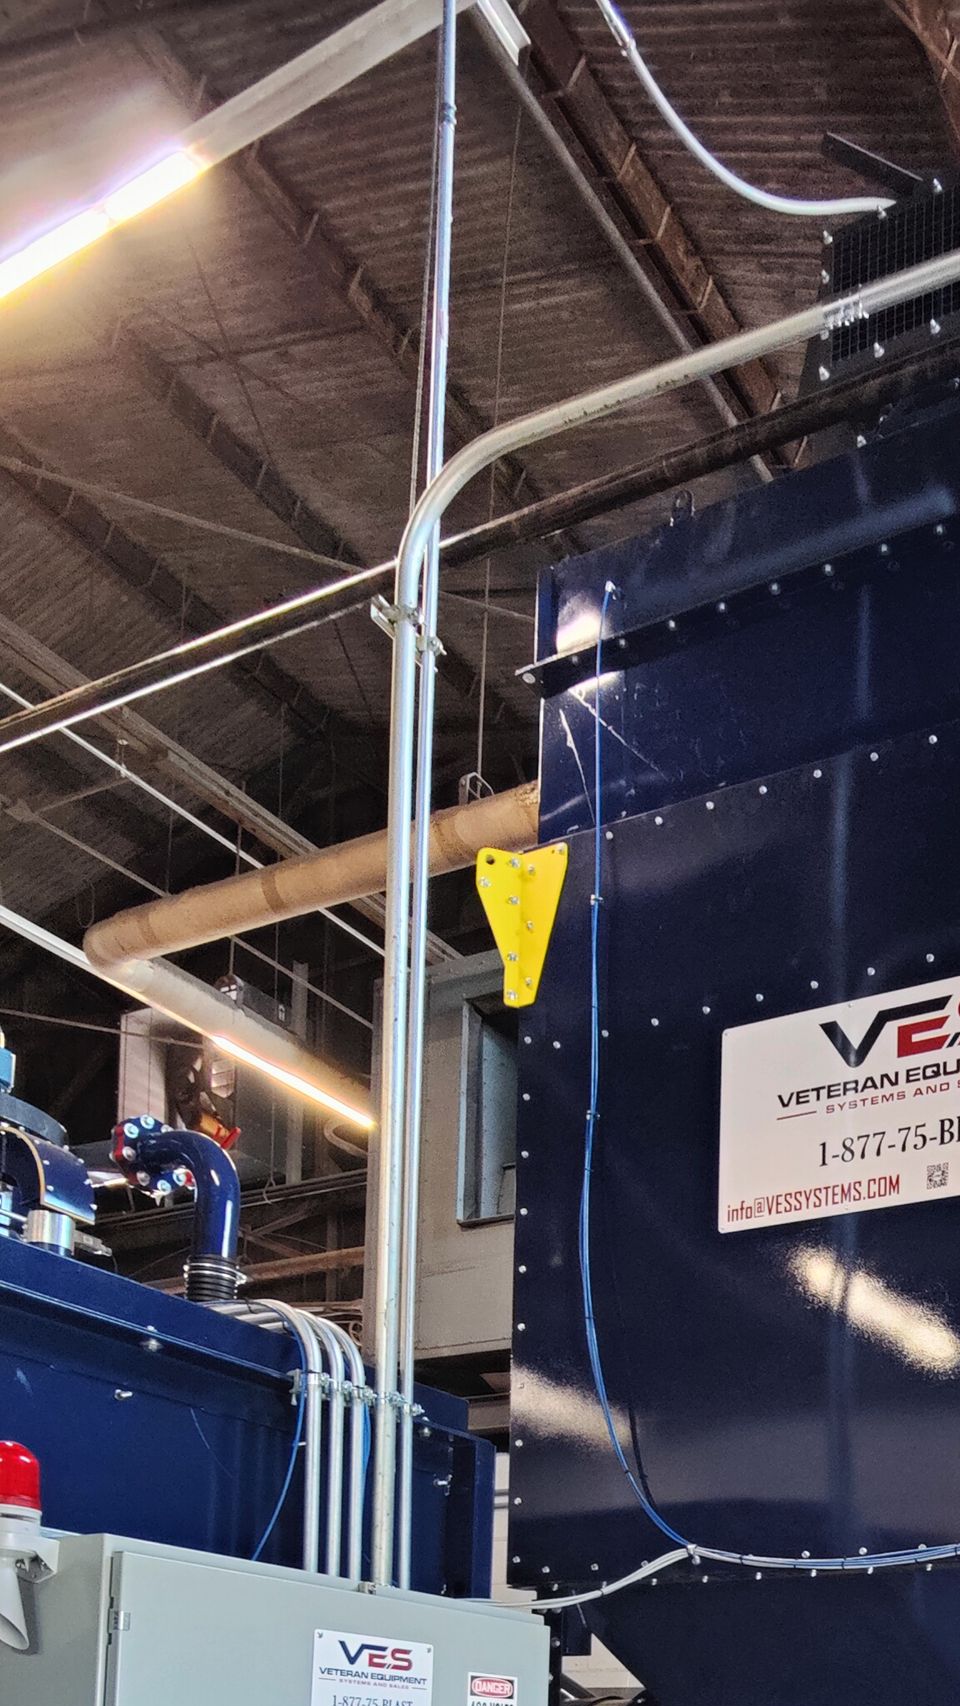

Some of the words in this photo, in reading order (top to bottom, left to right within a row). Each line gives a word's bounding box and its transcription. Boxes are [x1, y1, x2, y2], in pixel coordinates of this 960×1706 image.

[777, 1071, 899, 1108] VETERAN
[825, 1091, 906, 1114] SYSTEMS
[913, 1082, 950, 1097] AND
[727, 1174, 900, 1223] info@VESSYSTEMS.COM
[338, 1640, 413, 1671] VES
[319, 1667, 369, 1679] VETERAN
[370, 1673, 428, 1685] EQUIPMENT
[473, 1680, 509, 1695] DANGER
